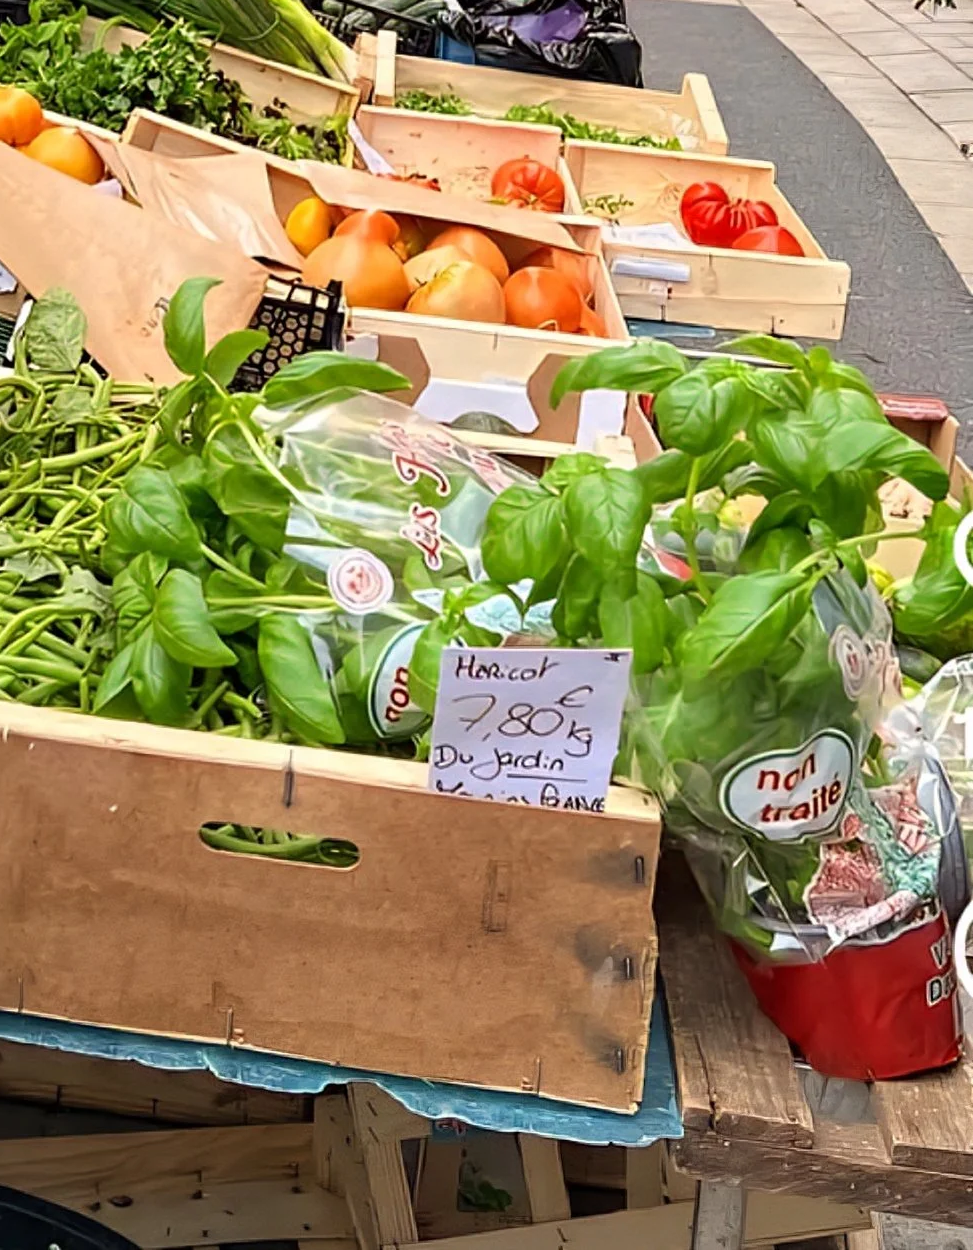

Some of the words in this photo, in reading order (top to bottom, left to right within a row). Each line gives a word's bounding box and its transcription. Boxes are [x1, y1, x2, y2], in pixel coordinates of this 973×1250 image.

[434, 744, 473, 770] Du
[757, 753, 816, 791] non
[760, 772, 842, 823] traité
